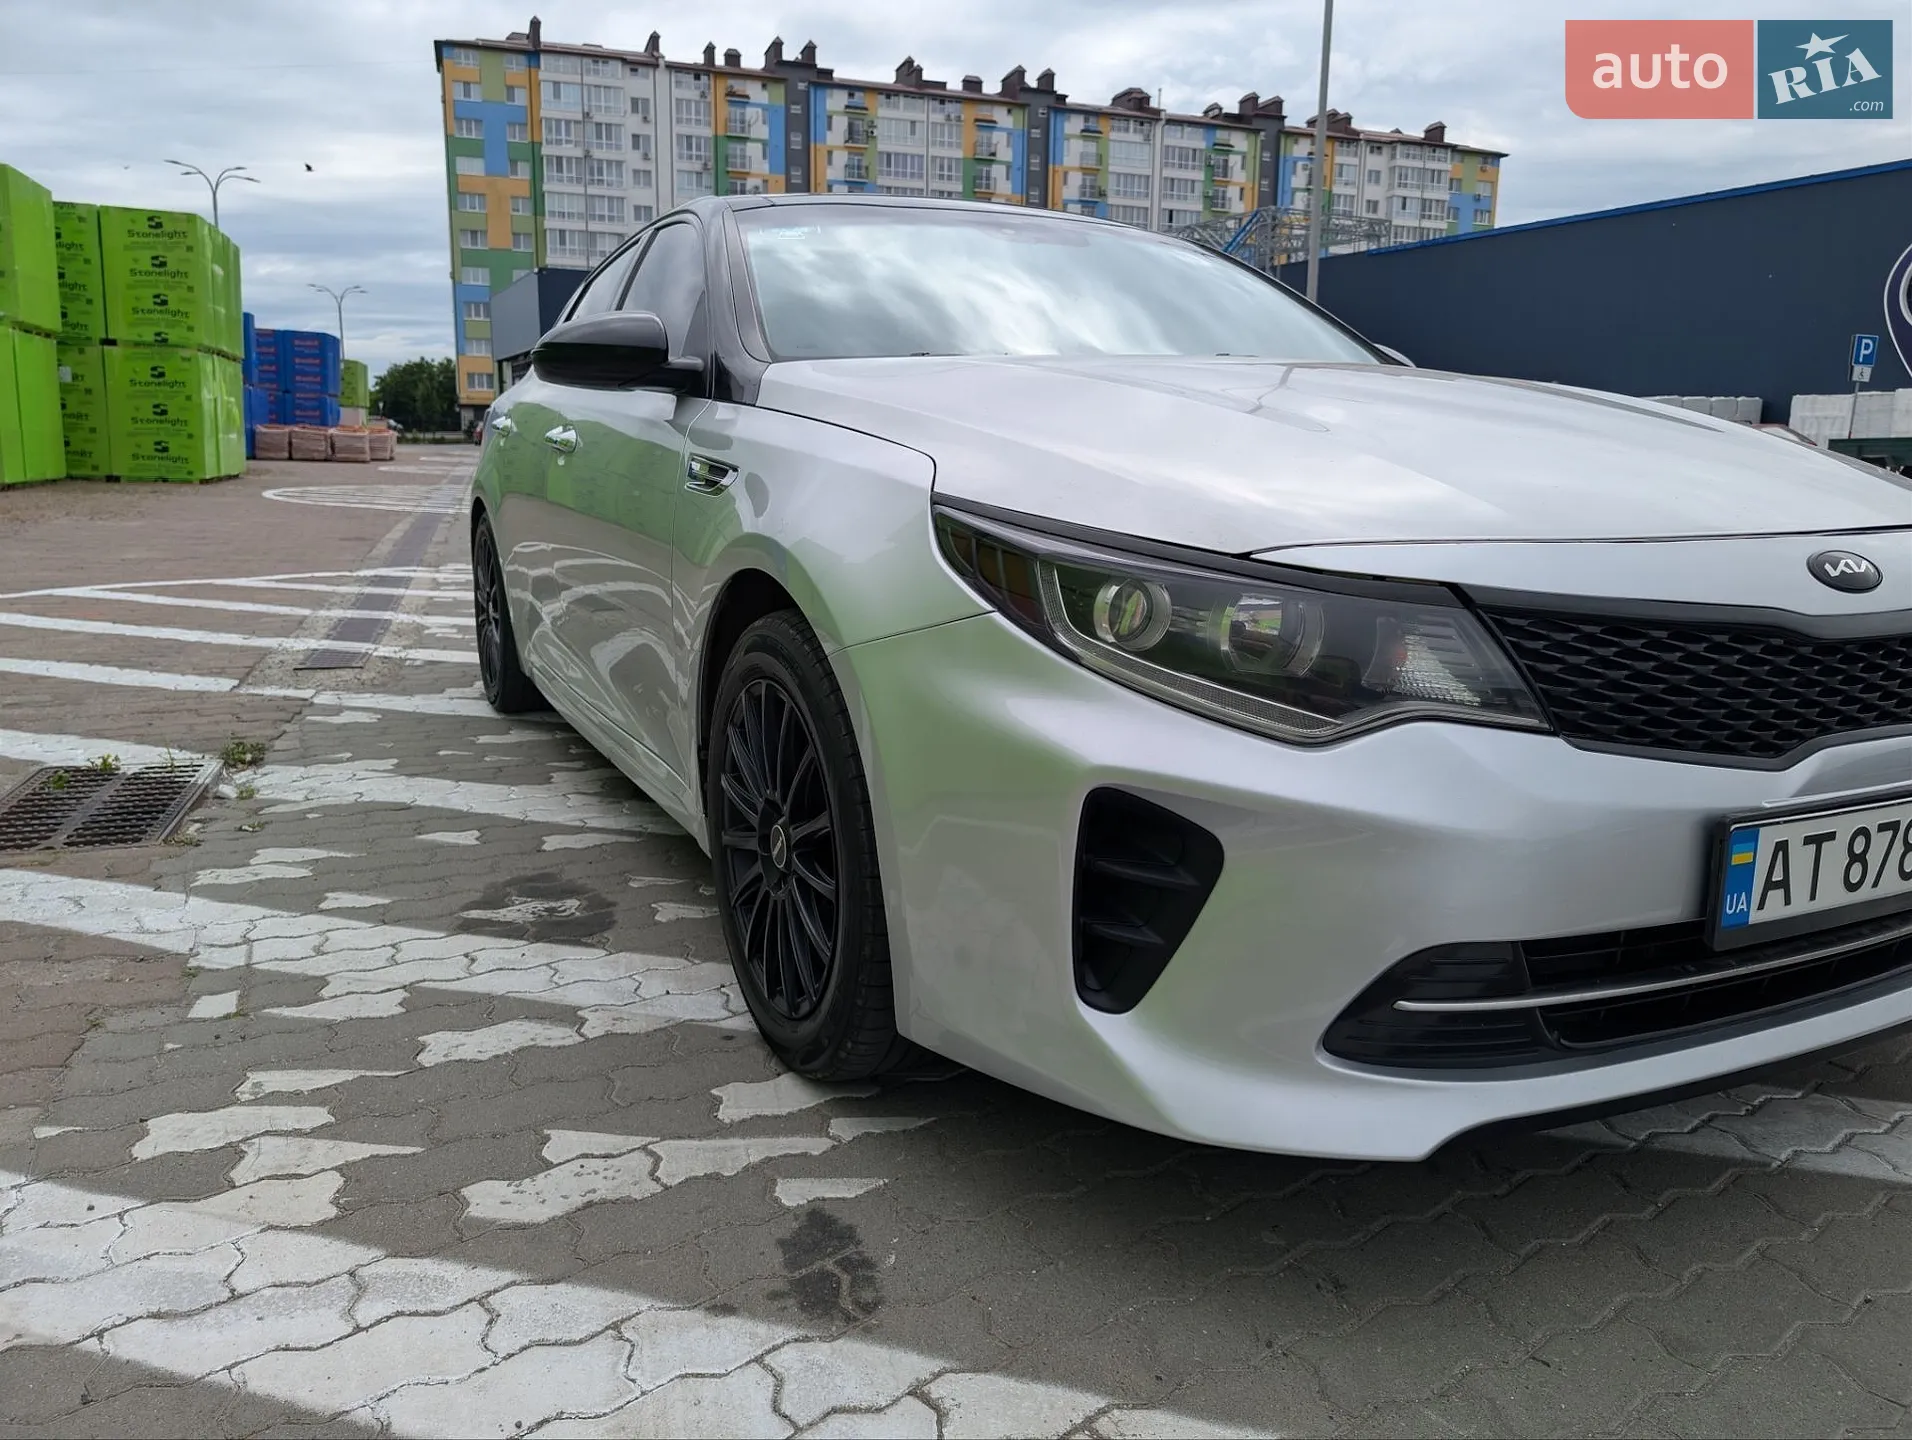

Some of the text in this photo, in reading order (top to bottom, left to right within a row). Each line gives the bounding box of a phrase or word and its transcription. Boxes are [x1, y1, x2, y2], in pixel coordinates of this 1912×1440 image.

[127, 229, 188, 240] Stonelight
[129, 268, 188, 279] Stonelight
[131, 306, 190, 318] Stonelight
[1859, 339, 1873, 362] P
[129, 379, 187, 389] Stonelight
[130, 416, 188, 427] Stonelight
[131, 452, 189, 464] Stonelight
[1726, 892, 1748, 914] UA
